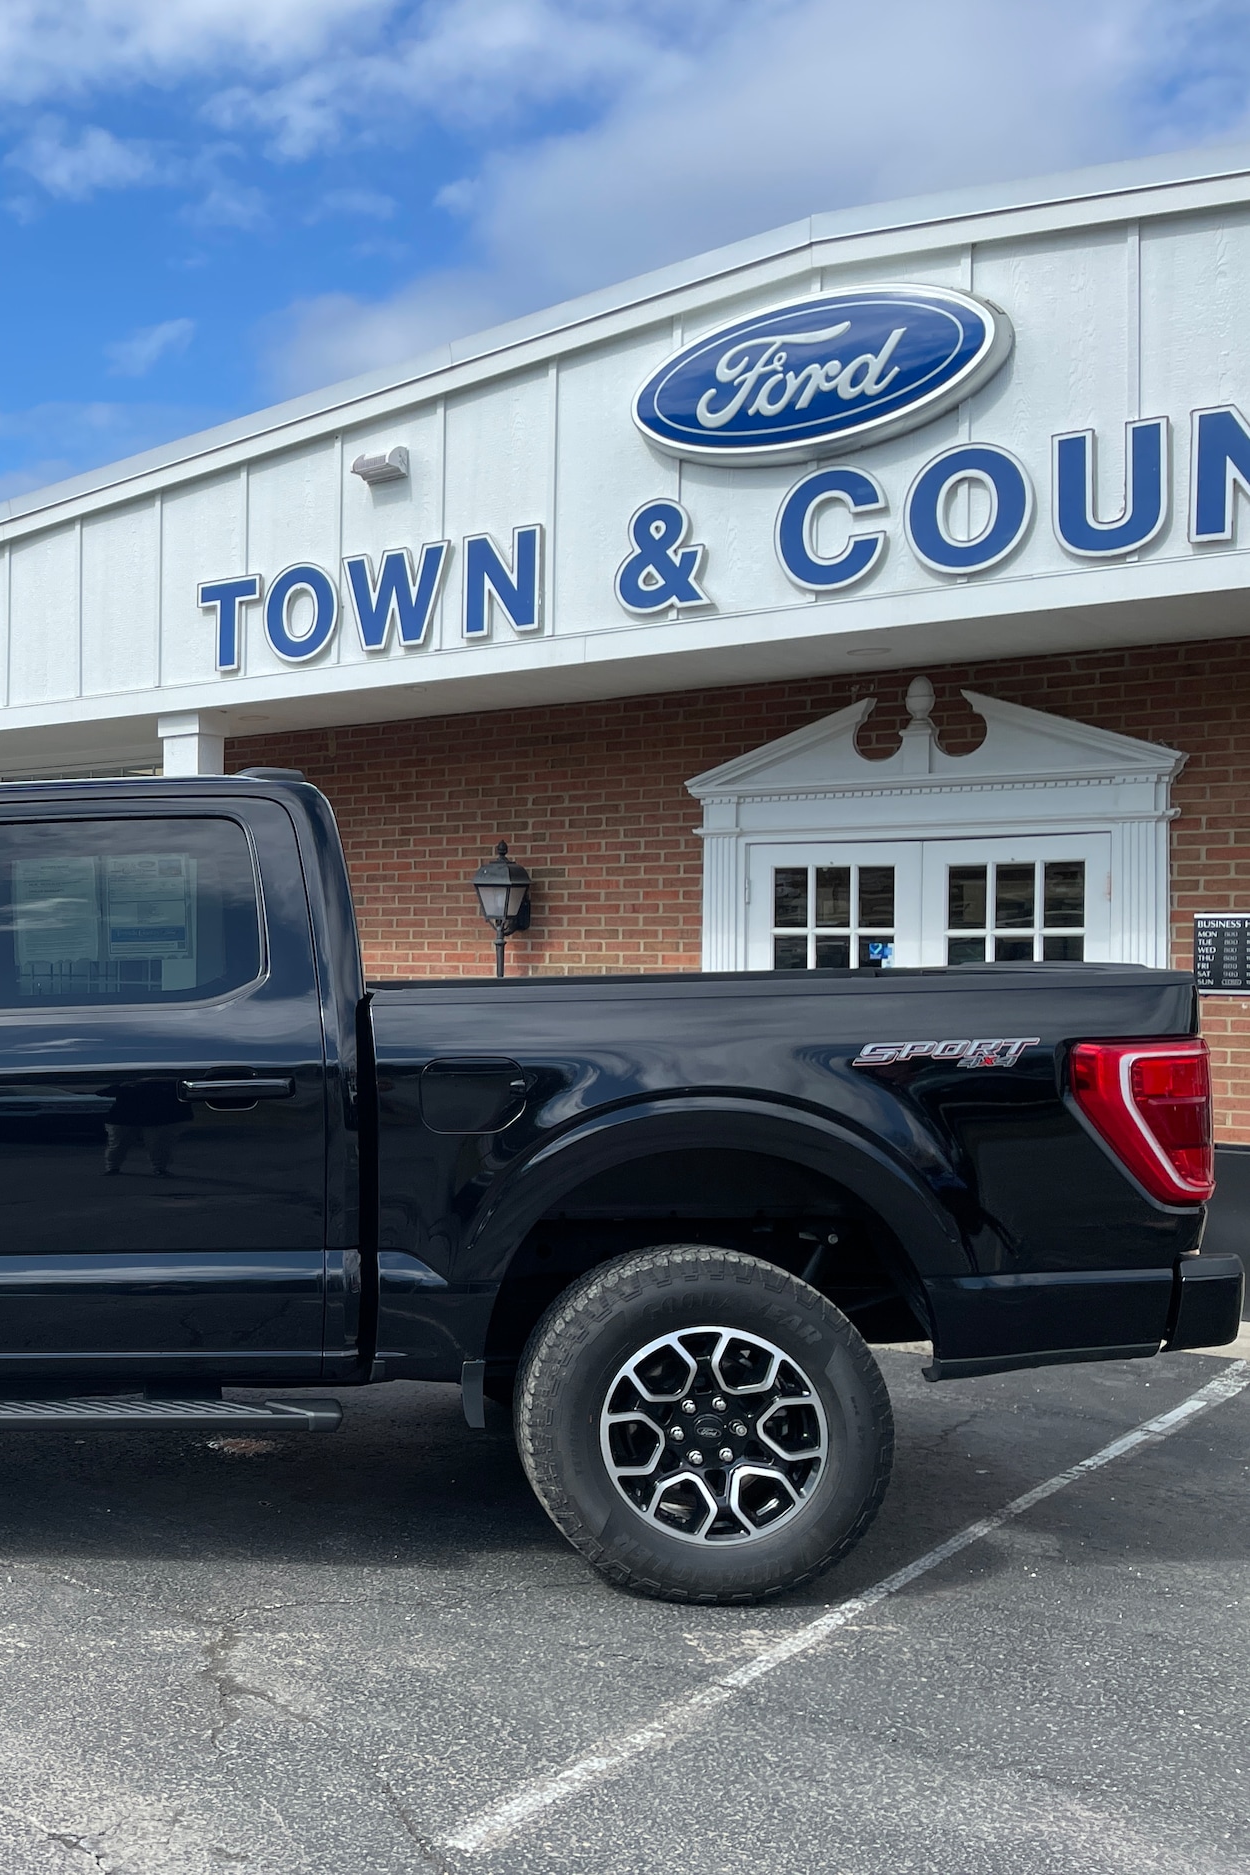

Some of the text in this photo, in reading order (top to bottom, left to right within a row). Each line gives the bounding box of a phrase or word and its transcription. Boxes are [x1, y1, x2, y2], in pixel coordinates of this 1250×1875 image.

[696, 321, 907, 428] Ford
[197, 523, 542, 672] TOWN
[614, 498, 713, 615] &
[1197, 920, 1241, 928] BUSINESS
[852, 1037, 1040, 1066] SPORT
